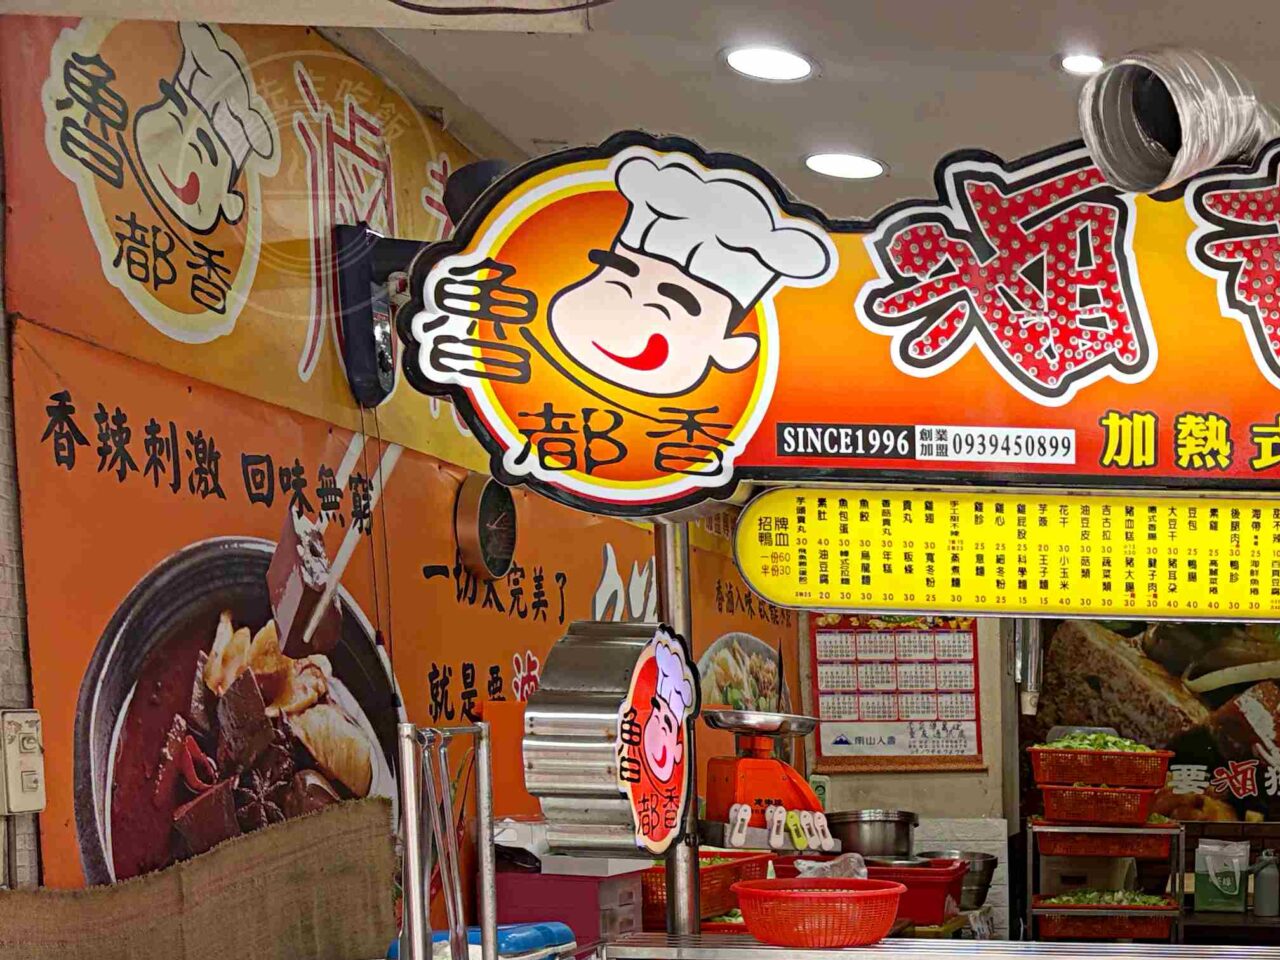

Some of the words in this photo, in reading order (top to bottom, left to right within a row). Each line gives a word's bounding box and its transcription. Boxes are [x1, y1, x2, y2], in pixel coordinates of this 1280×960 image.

[783, 427, 909, 455] SINCE1996
[952, 433, 1071, 457] 0939450899
[41, 391, 226, 501] 香辣刺激
[242, 453, 375, 536] 回味無窮
[1080, 505, 1090, 541] 油豆皮
[1188, 507, 1197, 531] 豆包
[1168, 506, 1177, 541] 大豆干
[796, 538, 808, 546] 30
[817, 538, 829, 546] 40
[839, 539, 850, 547] 30
[1187, 548, 1198, 556] 25
[1209, 549, 1219, 557] 25
[1060, 556, 1069, 590] 小玉米
[861, 592, 872, 600] 30
[975, 595, 986, 603] 30
[1040, 597, 1048, 605] 15
[1249, 602, 1260, 610] 30
